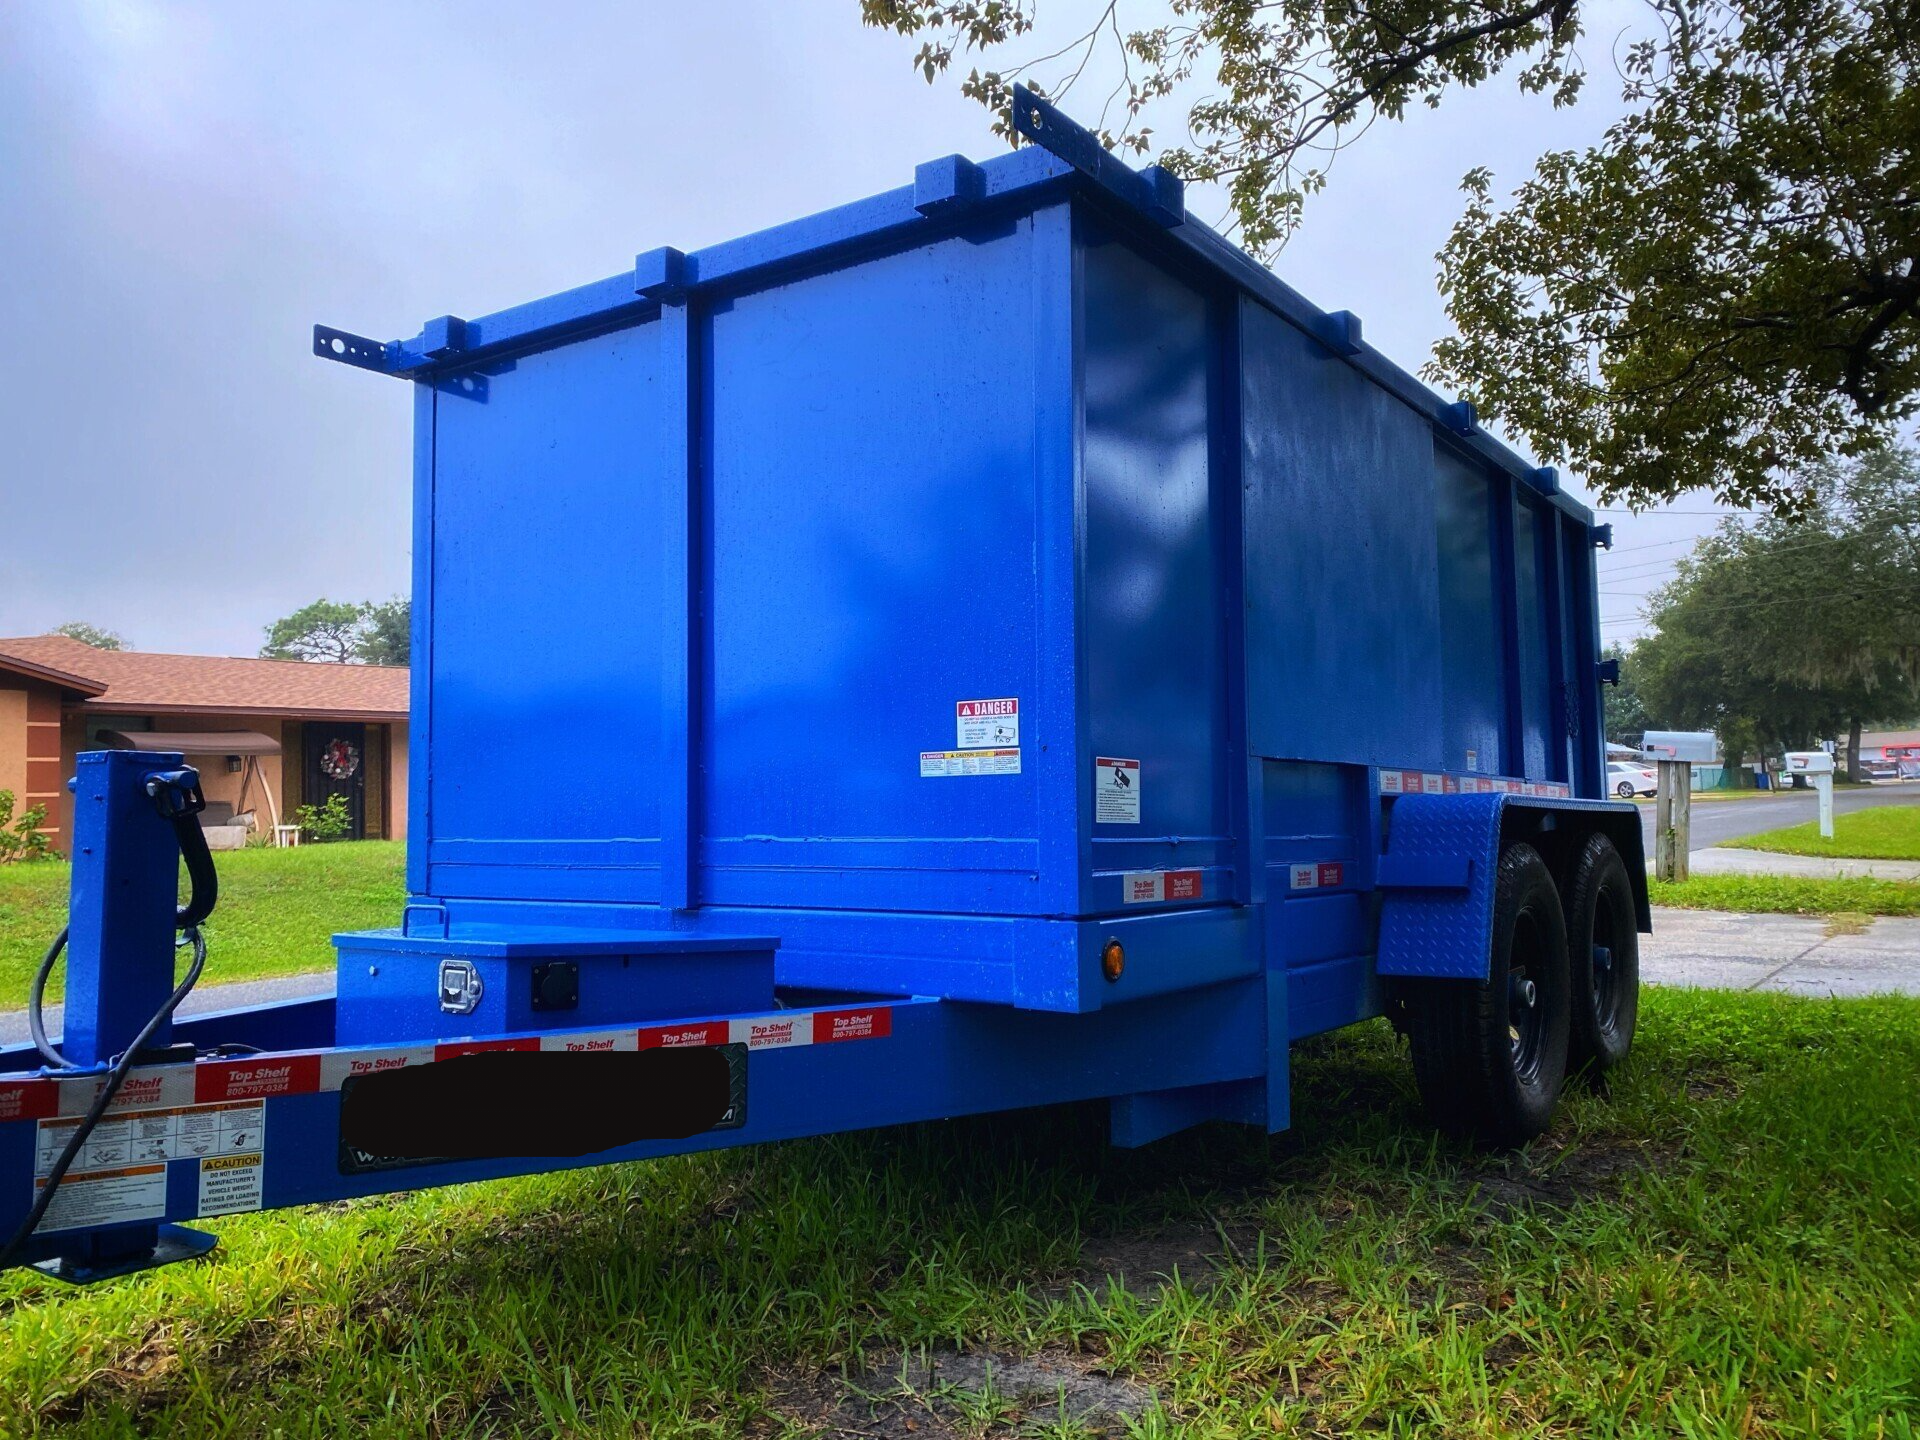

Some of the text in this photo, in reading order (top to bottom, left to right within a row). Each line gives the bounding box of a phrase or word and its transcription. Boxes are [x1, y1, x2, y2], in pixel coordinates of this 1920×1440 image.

[974, 701, 1013, 715] DANGER
[833, 1015, 872, 1028] Top Shelf
[751, 1022, 793, 1036] Top Shelf
[832, 1028, 872, 1038] 800-797-0384
[662, 1031, 707, 1045] Top Shelf
[750, 1036, 792, 1047] 800-797-0384
[566, 1039, 615, 1051] Top Shelf
[351, 1061, 372, 1073] Top
[375, 1057, 407, 1069] Shelf
[229, 1066, 291, 1082] Top Shelf
[124, 1077, 163, 1090] Shelf
[226, 1083, 288, 1096] 800-797-0384
[214, 1156, 260, 1169] CAUTION
[232, 1168, 253, 1176] EXCEED
[206, 1176, 256, 1187] MANUFACTURER'S
[208, 1184, 253, 1195] VEHICLE WEIGHT
[201, 1196, 225, 1204] RATINGS
[235, 1191, 260, 1199] LOADING
